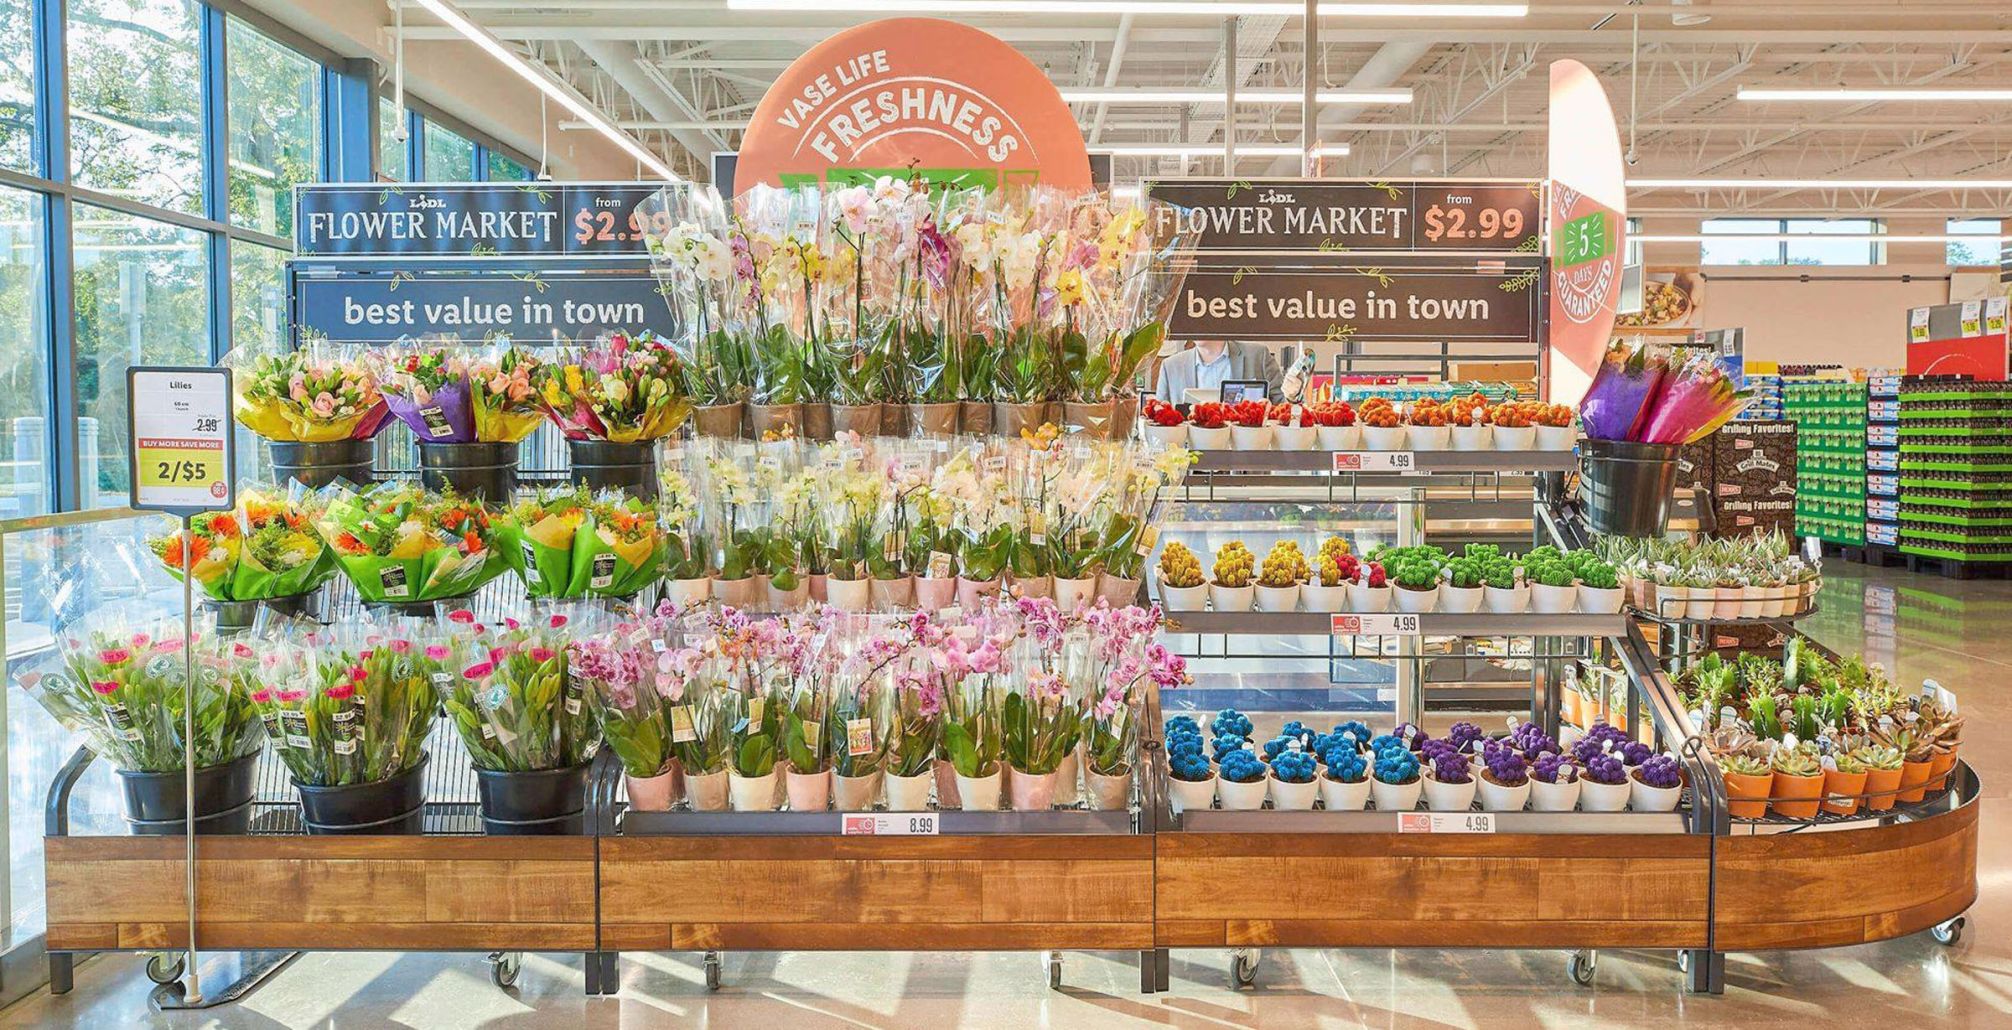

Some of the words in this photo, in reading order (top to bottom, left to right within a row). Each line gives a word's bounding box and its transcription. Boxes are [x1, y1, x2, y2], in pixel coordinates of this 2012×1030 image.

[777, 74, 838, 130] VASE
[835, 50, 891, 87] LIFE
[810, 88, 1019, 164] FRESHNESS
[595, 197, 621, 207] from
[1446, 194, 1472, 205] from
[308, 211, 427, 243] FLOWER
[436, 211, 557, 242] MARKET
[1155, 206, 1275, 238] FLOWER
[1283, 206, 1408, 239] MARKET
[1424, 203, 1524, 243] $2.99
[1579, 221, 1589, 257] 5
[1573, 265, 1593, 284] DAYS
[1558, 259, 1612, 316] GUARANTEED
[344, 297, 414, 324] best
[424, 296, 513, 325] value
[523, 295, 553, 324] in
[564, 302, 644, 325] town
[1187, 290, 1258, 319] best
[1267, 290, 1356, 319] value
[1366, 290, 1397, 319] in
[1408, 295, 1489, 320] town
[169, 381, 192, 390] Lilies
[197, 418, 218, 432] 2.99
[1721, 424, 1752, 435] Grilling
[1753, 424, 1794, 433] Favorites!
[143, 440, 159, 448] BUY
[160, 440, 179, 448] MORE
[180, 440, 198, 448] SAVE
[199, 440, 219, 448] MORE
[1389, 454, 1409, 467] 4.99
[158, 460, 206, 482] 2/$5
[1723, 501, 1752, 511] Grilling
[1753, 500, 1793, 510] Favorites!
[1393, 616, 1417, 631] 4.99
[909, 817, 933, 833] 8.99
[1465, 816, 1489, 831] 4.99
